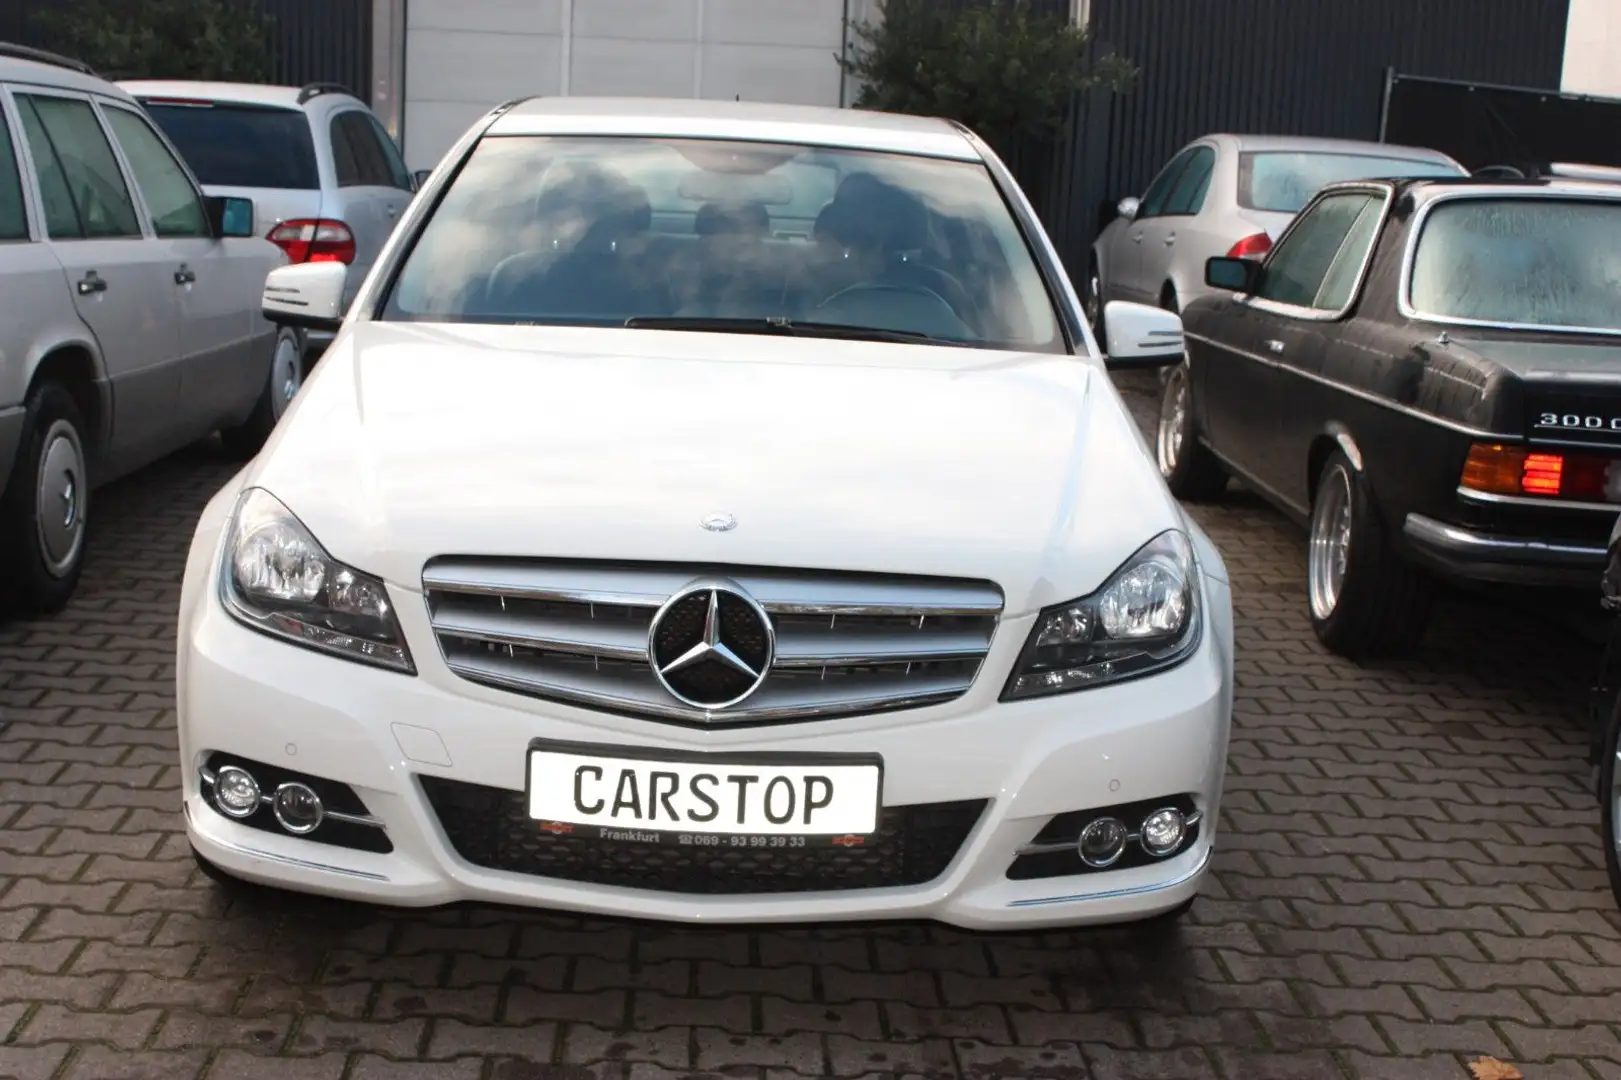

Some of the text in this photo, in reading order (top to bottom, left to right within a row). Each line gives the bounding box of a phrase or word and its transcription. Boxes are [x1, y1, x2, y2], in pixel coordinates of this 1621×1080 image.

[574, 765, 834, 825] CARSTOP
[600, 828, 660, 843] Frankfurt
[731, 835, 747, 847] 93
[751, 835, 767, 847] 99
[770, 836, 786, 847] 39
[789, 836, 805, 847] 33
